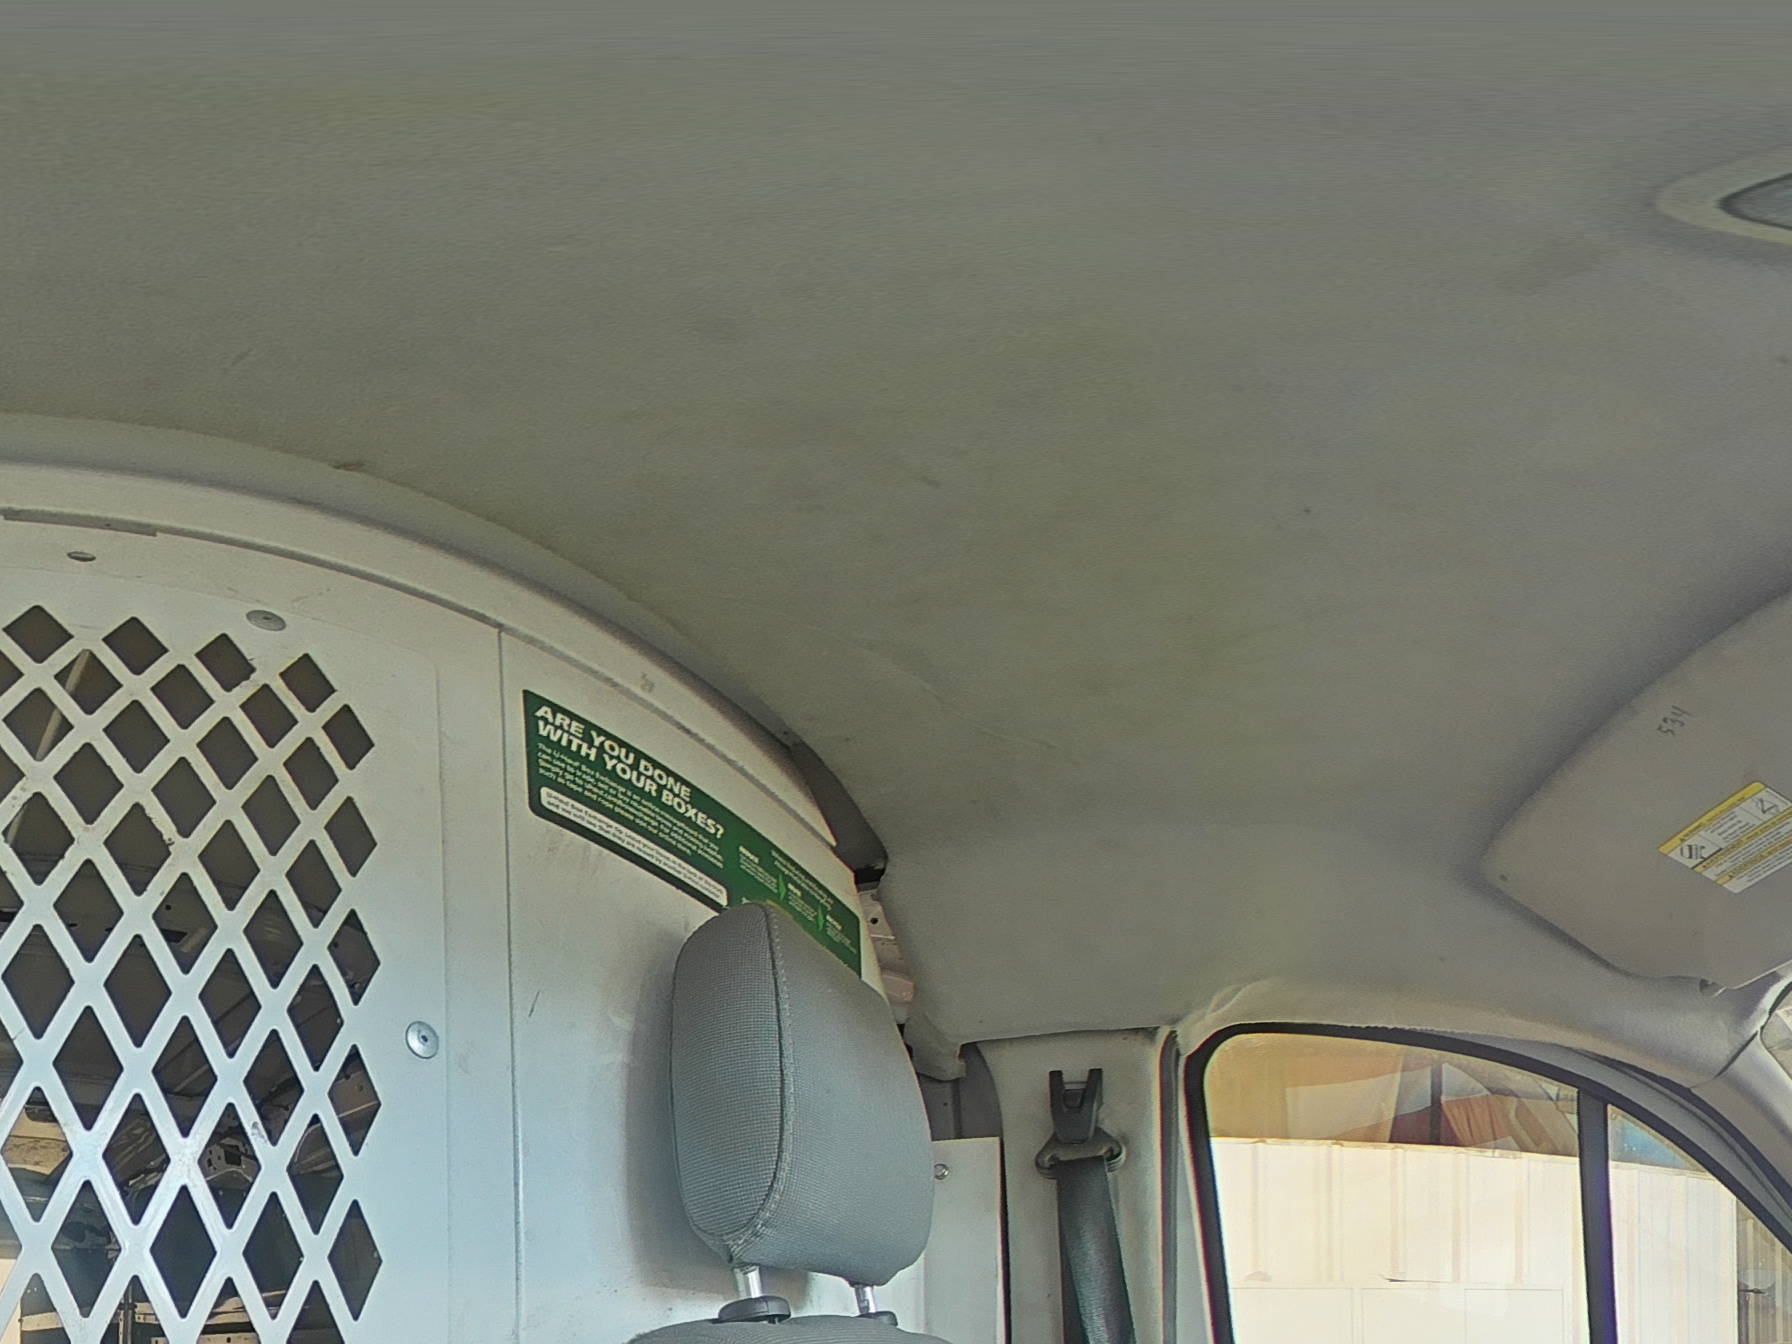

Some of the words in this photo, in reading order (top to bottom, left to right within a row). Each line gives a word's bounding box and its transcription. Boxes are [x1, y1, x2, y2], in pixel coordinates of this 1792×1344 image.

[535, 706, 585, 737] ARE
[591, 730, 635, 765] YOU
[639, 759, 691, 802] DONE
[538, 720, 598, 761] WITH
[602, 753, 658, 797] YOUR
[661, 789, 725, 839] BOXES?
